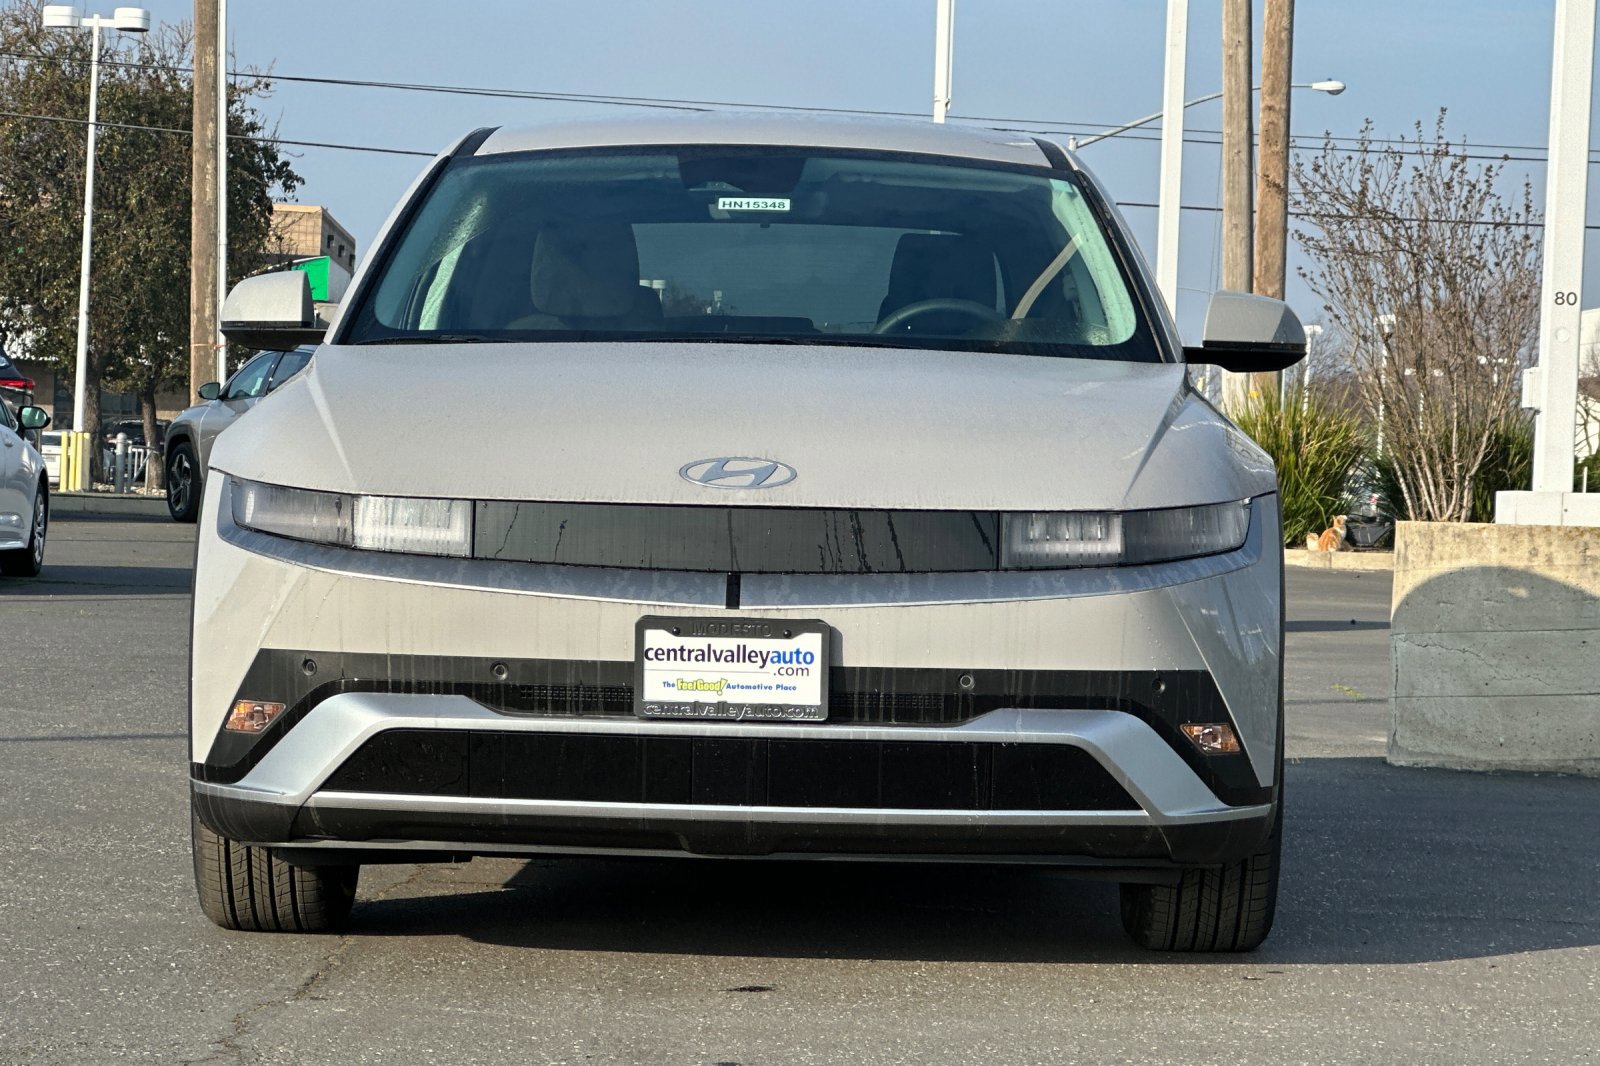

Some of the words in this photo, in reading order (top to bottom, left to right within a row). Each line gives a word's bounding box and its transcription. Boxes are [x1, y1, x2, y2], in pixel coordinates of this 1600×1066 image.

[722, 200, 786, 209] HN15348
[1554, 291, 1578, 306] 80
[644, 643, 815, 669] centralvalleyauto
[773, 665, 810, 677] .com
[662, 680, 676, 688] The
[726, 682, 773, 691] Automotive
[643, 701, 819, 721] centralvalleyauto.com
